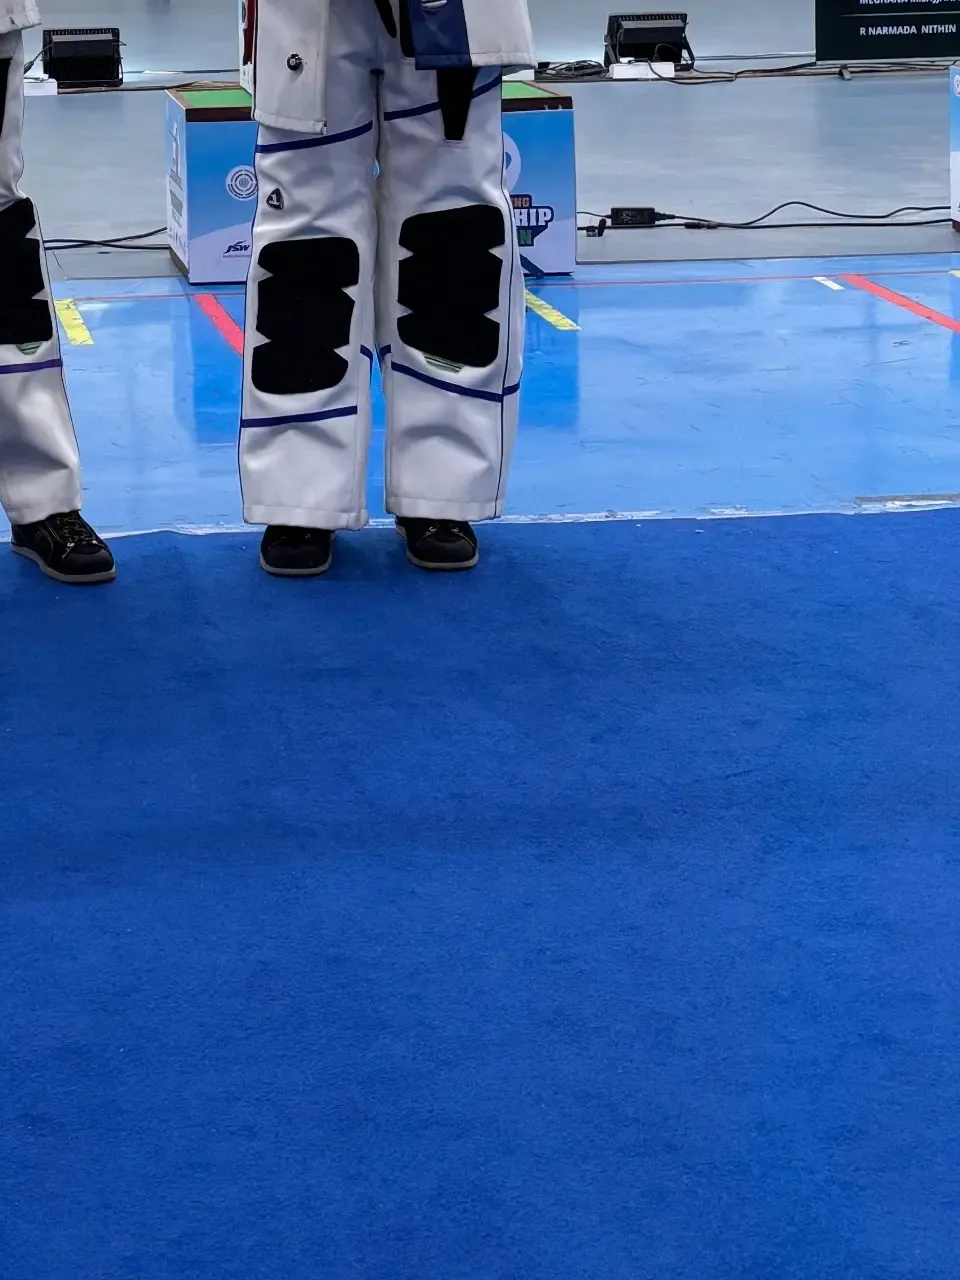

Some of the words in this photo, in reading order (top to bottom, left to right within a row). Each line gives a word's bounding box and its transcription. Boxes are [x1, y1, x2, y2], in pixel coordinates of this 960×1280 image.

[859, 26, 867, 36] R
[868, 25, 918, 36] NARMADA
[921, 23, 957, 34] NITHIN
[515, 208, 553, 227] HIP
[223, 244, 250, 254] JSW
